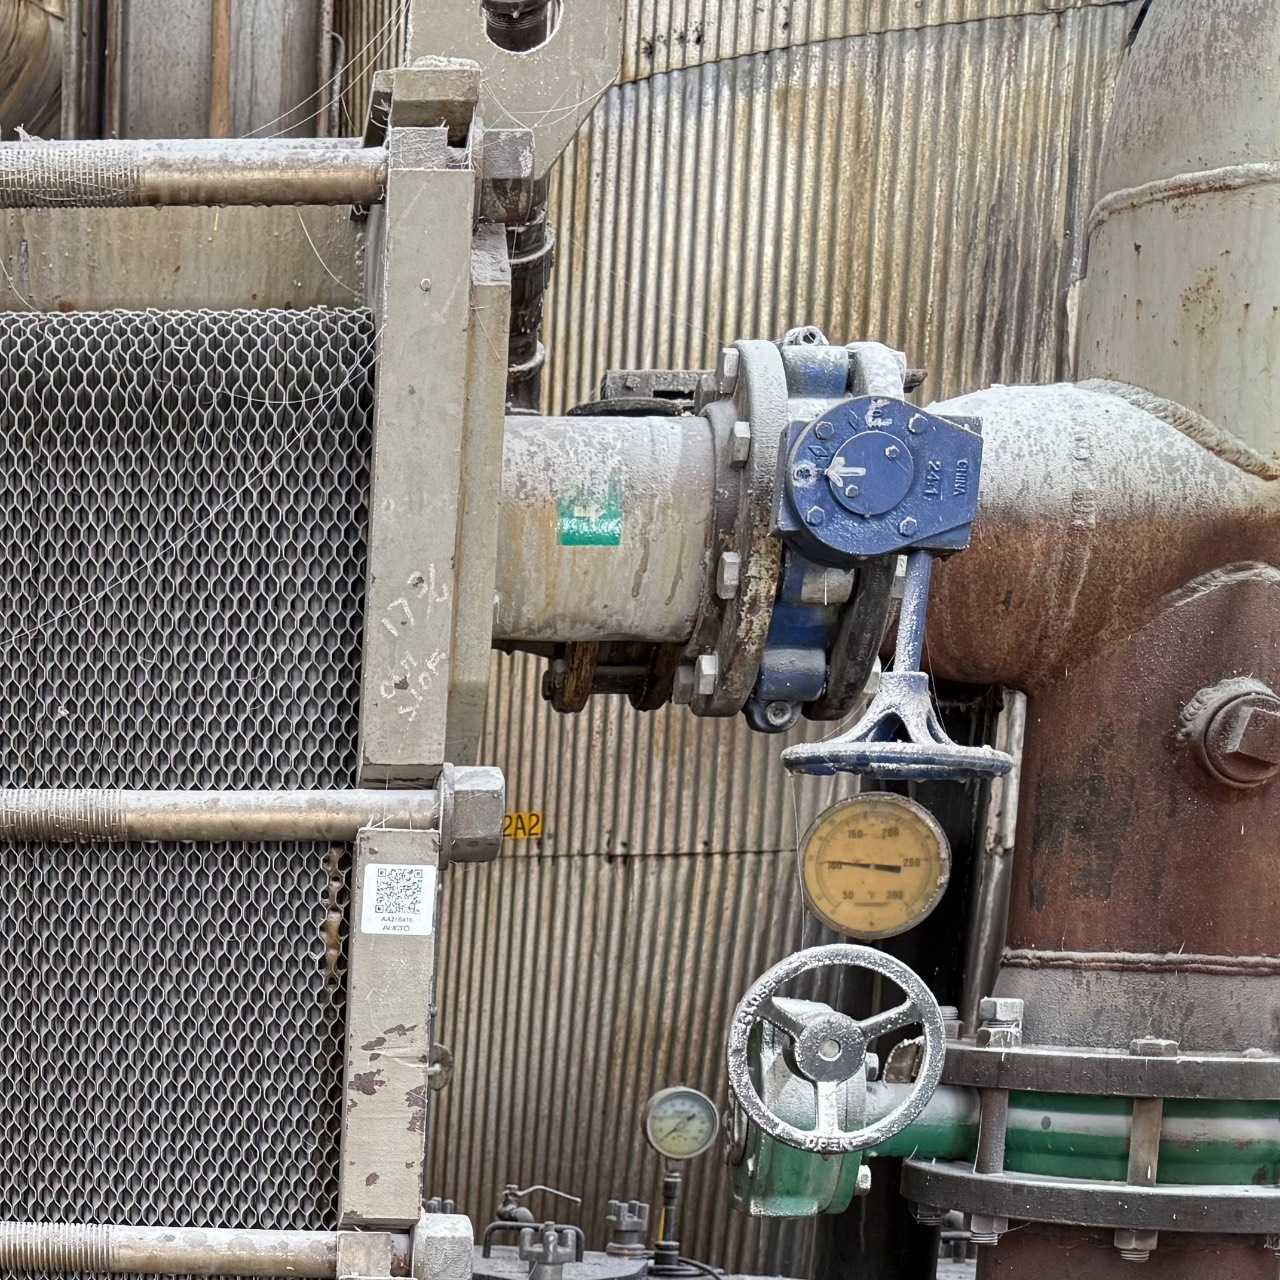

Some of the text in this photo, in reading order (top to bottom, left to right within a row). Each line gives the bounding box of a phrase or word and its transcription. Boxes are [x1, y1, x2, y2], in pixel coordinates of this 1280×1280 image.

[951, 457, 969, 496] CHINA
[502, 813, 540, 838] 2A2
[804, 1135, 855, 1151] OPEN
